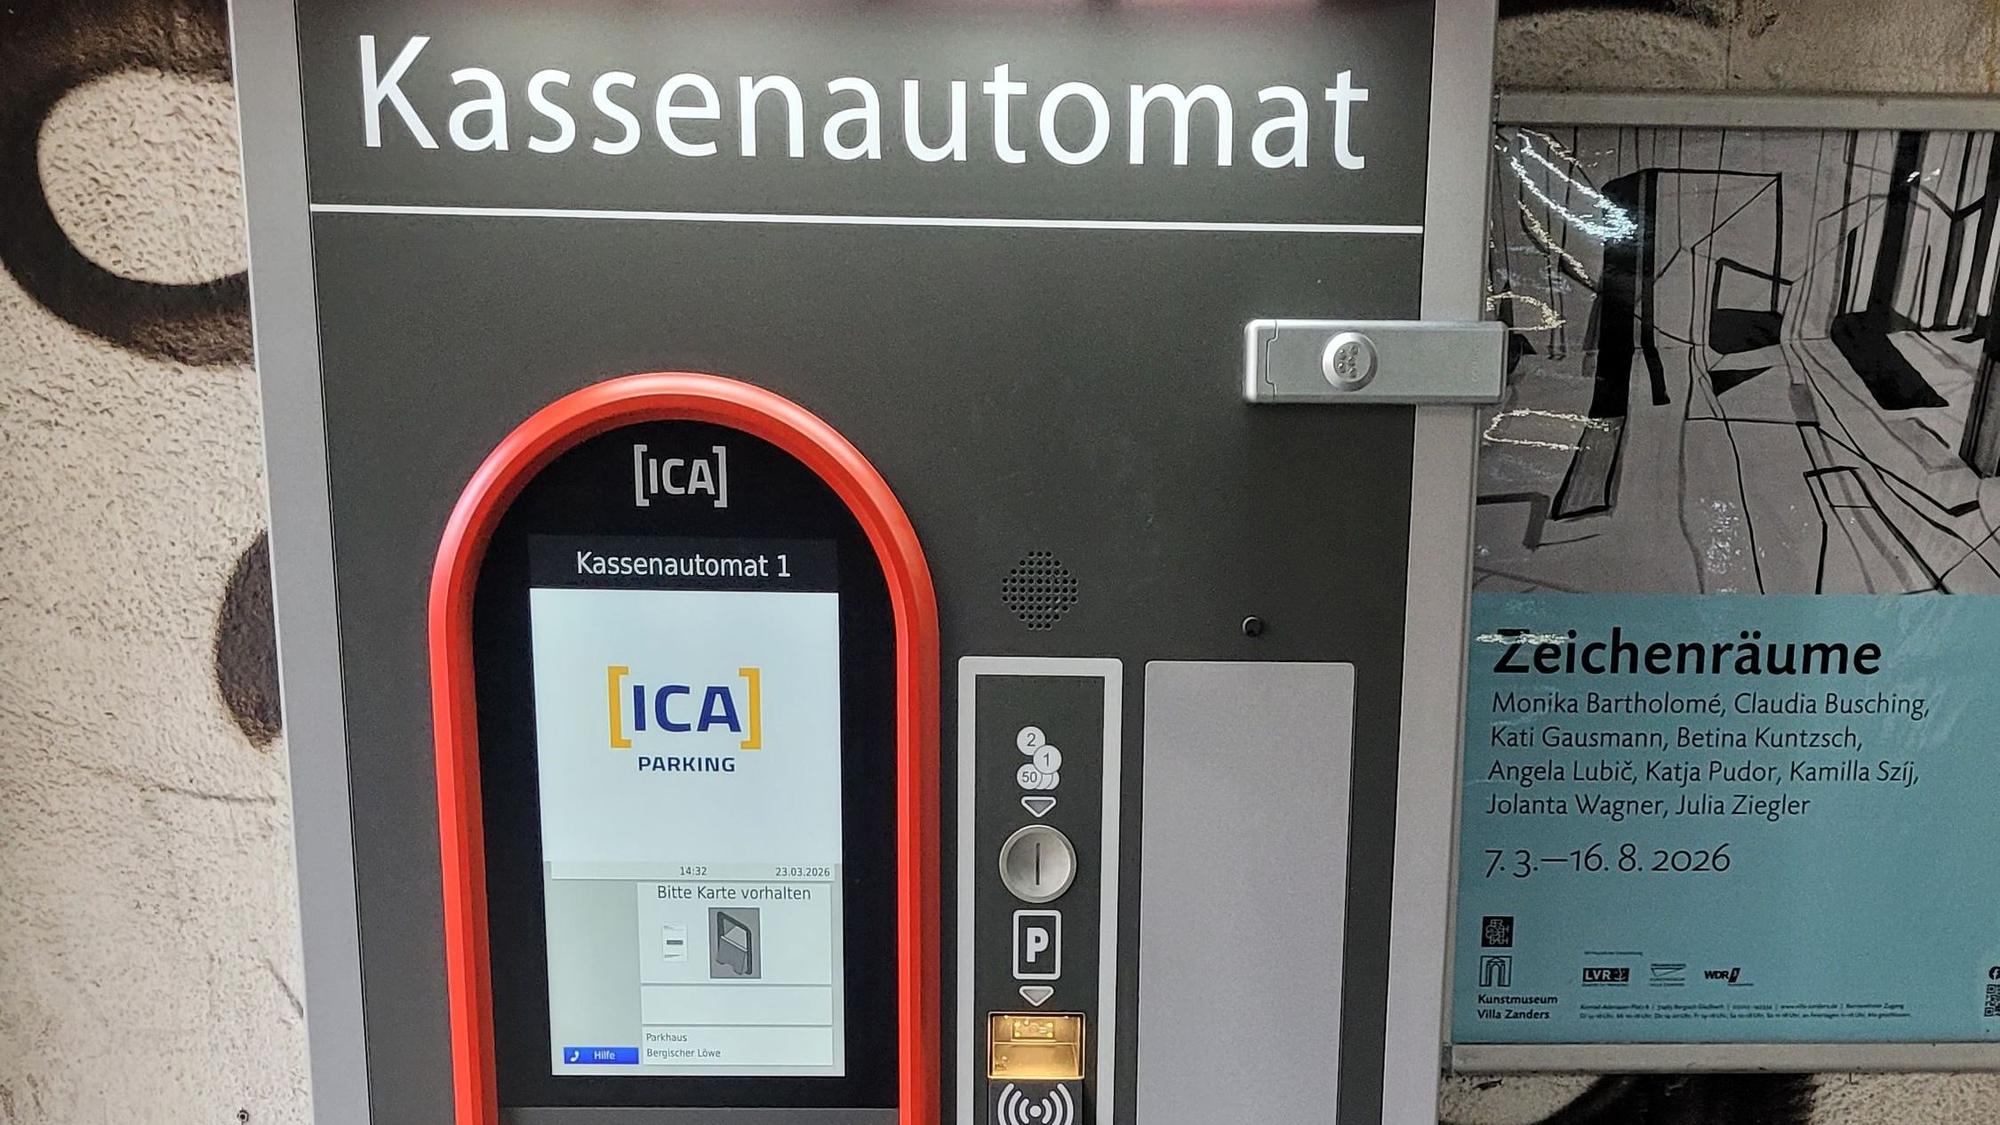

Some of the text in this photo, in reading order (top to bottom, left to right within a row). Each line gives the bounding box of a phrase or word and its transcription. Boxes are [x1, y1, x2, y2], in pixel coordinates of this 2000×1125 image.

[360, 34, 1369, 170] Kassenautomat
[576, 551, 791, 577] Kassenautomat 1
[1493, 626, 1882, 675] Zeichenräume
[1492, 691, 1929, 721] Monika Bartholomé, Claudia Busching,
[1026, 732, 1036, 747] 2
[1491, 726, 1862, 751] Kati Gausmann, Betina Kuntzsch,
[638, 756, 736, 772] PARKING
[1043, 753, 1050, 767] 1
[1021, 771, 1038, 783] 50
[1488, 760, 1919, 788] Angela Lubič, Katja Pudor, Kamilla Szíj,
[1486, 793, 1811, 822] Jolanta Wagner, Julia Ziegler
[1651, 843, 1731, 872] 2026
[680, 866, 831, 877] 14:32 23.03.2026
[657, 885, 812, 900] Bitte Karte vorhalten
[1026, 927, 1049, 963] P
[1585, 970, 1611, 980] LVR
[1704, 970, 1730, 980] WDR
[1478, 994, 1558, 1004] Kunstmuseum
[1477, 1009, 1550, 1019] Villa Zanders
[646, 1032, 688, 1042] Parkhaus
[593, 1051, 616, 1060] Hilfe
[646, 1048, 721, 1060] Bergischer Löwe
